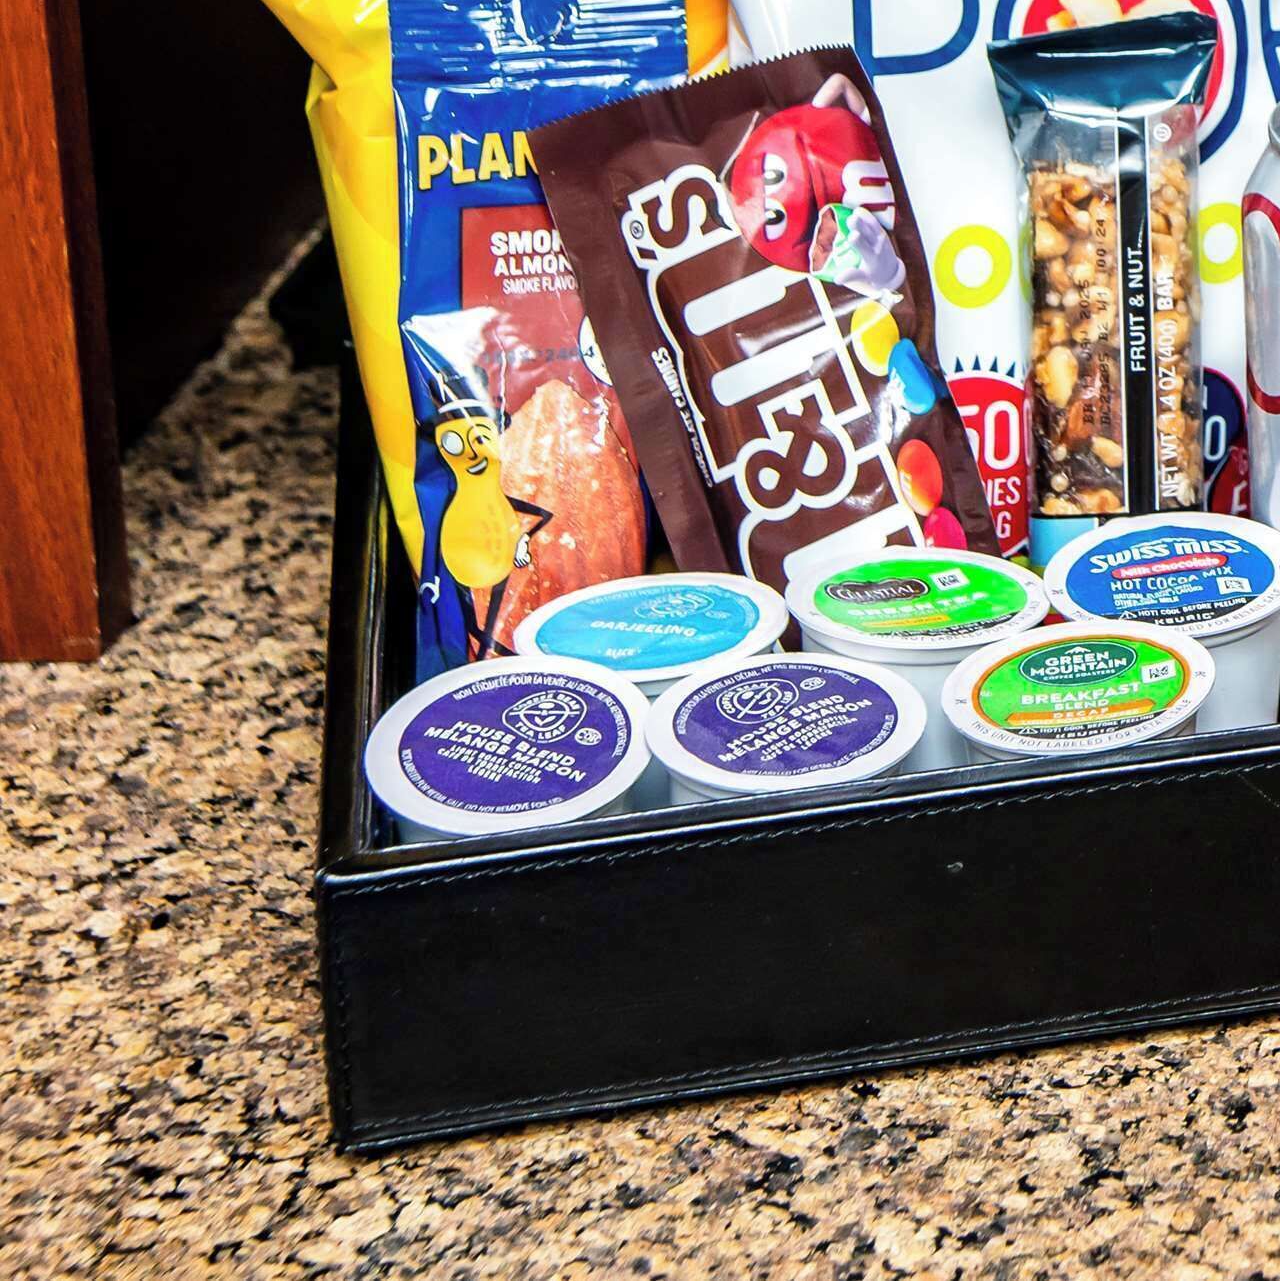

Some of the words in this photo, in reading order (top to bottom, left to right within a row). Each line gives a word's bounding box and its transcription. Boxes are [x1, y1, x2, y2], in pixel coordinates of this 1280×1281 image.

[417, 130, 542, 191] PLAN
[489, 229, 566, 257] SMO
[1127, 246, 1145, 290] NUT
[501, 275, 542, 295] SMOKE
[1129, 294, 1146, 309] &
[1130, 312, 1147, 373] FRUIT
[1158, 365, 1177, 391] OZ
[957, 398, 1022, 472] 50
[1161, 463, 1181, 498] NET
[1089, 538, 1171, 574] SWISS
[1173, 537, 1246, 555] MISS
[1150, 556, 1222, 574] Chocolate
[1111, 579, 1145, 592] HOT
[1147, 575, 1199, 591] COCOA
[1203, 565, 1234, 578] MIX
[1161, 607, 1181, 616] COOL
[1183, 601, 1212, 613] BEFORE
[1214, 596, 1248, 609] PEELING
[590, 620, 698, 638] DARJEELING
[1154, 612, 1212, 626] KEURIG
[1030, 657, 1127, 677] MOUNTAIN
[1045, 650, 1110, 666] GREEN
[509, 674, 533, 687] POUR
[1043, 672, 1074, 681] COFFEE
[1075, 668, 1116, 679] ROASTERS
[1020, 682, 1141, 705] BREAKFAST
[1053, 699, 1110, 712] BLEND
[726, 714, 788, 751] HOUSE
[789, 693, 845, 718] BLEND
[802, 698, 874, 723] MAISON
[448, 719, 517, 745] HOUSE
[515, 739, 577, 768] BLEND
[537, 723, 567, 740] LEAF
[761, 738, 788, 755] LIGHT
[788, 723, 818, 741] ROAST
[511, 751, 588, 783] MAISON
